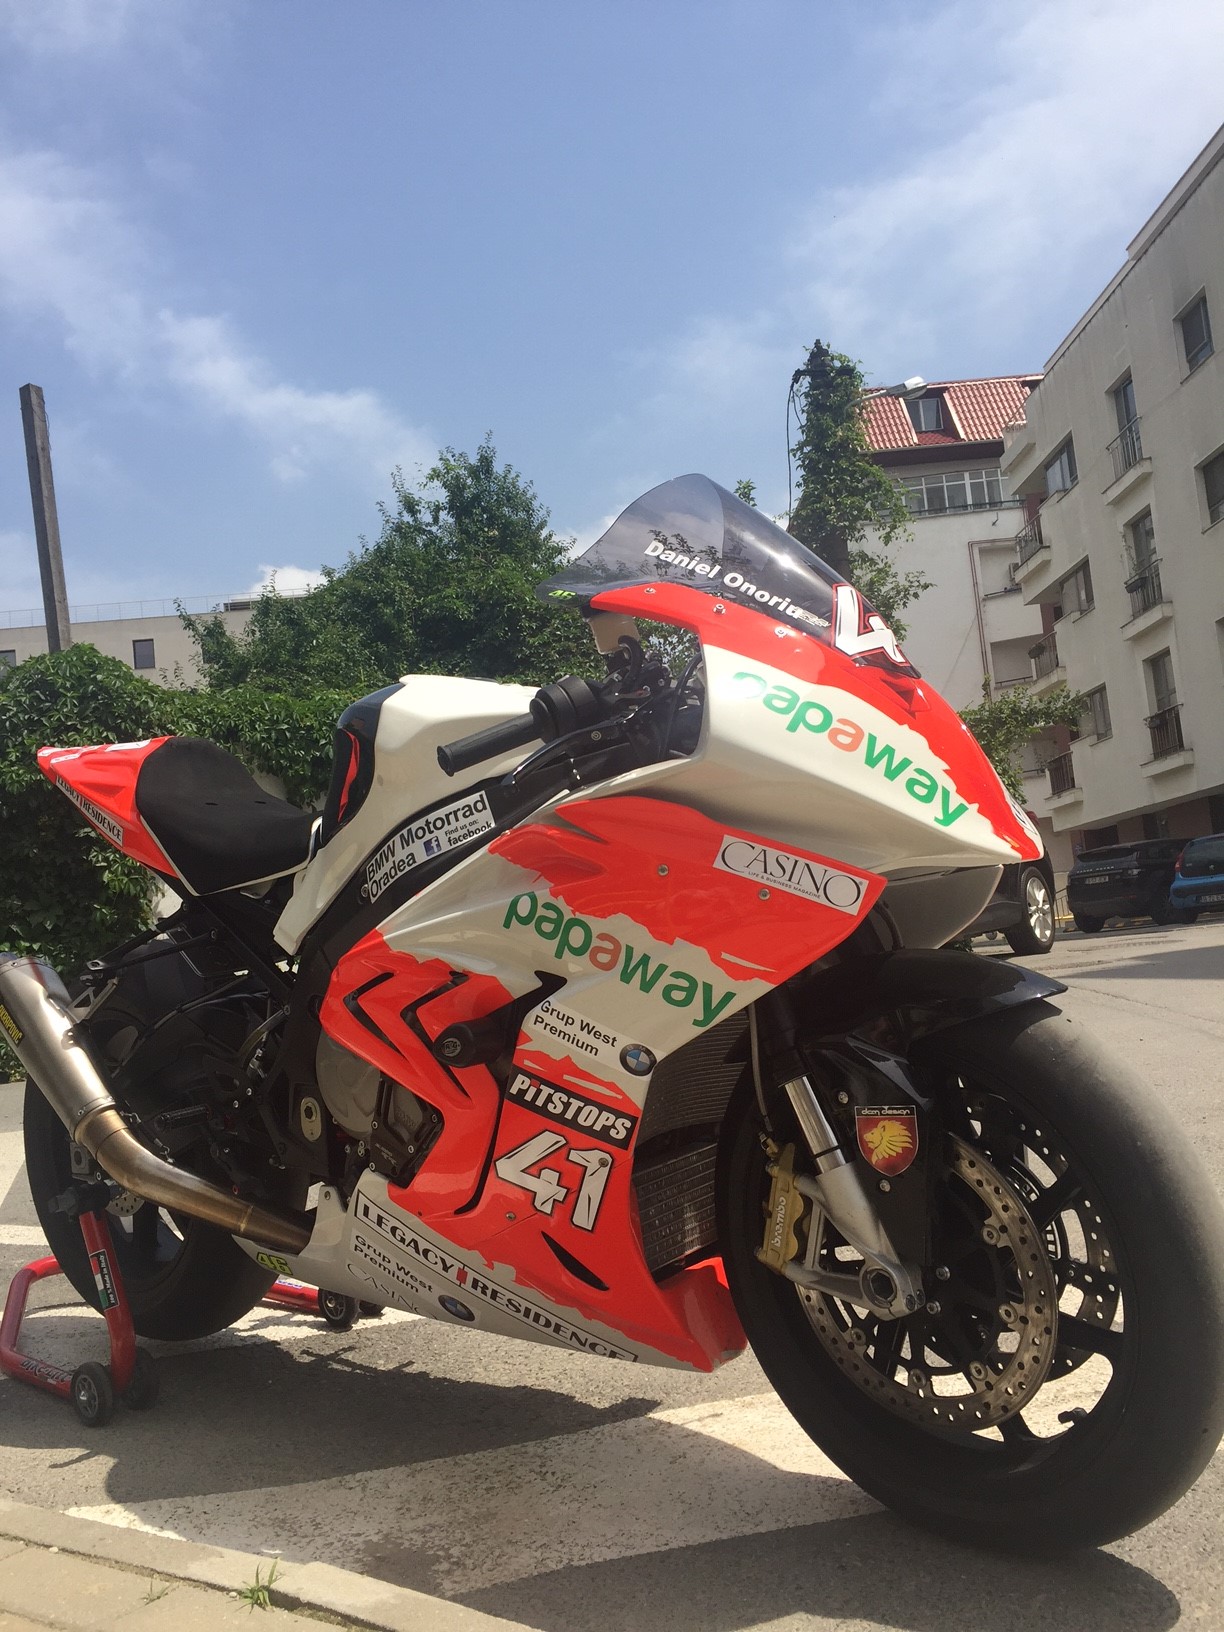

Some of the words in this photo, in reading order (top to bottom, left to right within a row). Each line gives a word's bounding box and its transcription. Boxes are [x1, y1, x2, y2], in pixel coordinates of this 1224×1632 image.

[643, 540, 722, 579] Daniel
[82, 799, 122, 842] RESIDENCE
[367, 840, 396, 882] BMW
[400, 794, 488, 851] Motorrad
[445, 825, 459, 837] Find
[460, 823, 468, 831] us
[447, 821, 492, 847] facebook
[370, 852, 417, 898] Oradea
[721, 841, 861, 908] CASINO
[748, 871, 760, 879] LIFE
[765, 876, 792, 889] BUSINESS
[793, 885, 821, 899] MAGAZINE
[503, 890, 736, 1028] papaway
[533, 1014, 599, 1056] Premium
[541, 1000, 575, 1027] Grup
[580, 1019, 618, 1047] West
[881, 1106, 911, 1116] design
[495, 1129, 614, 1233] 41
[363, 1203, 454, 1274] LEGACY
[771, 1196, 786, 1248] brembo
[256, 1251, 293, 1276] 46
[354, 1244, 419, 1293] Premium
[355, 1235, 391, 1264] Grup
[396, 1262, 433, 1293] West
